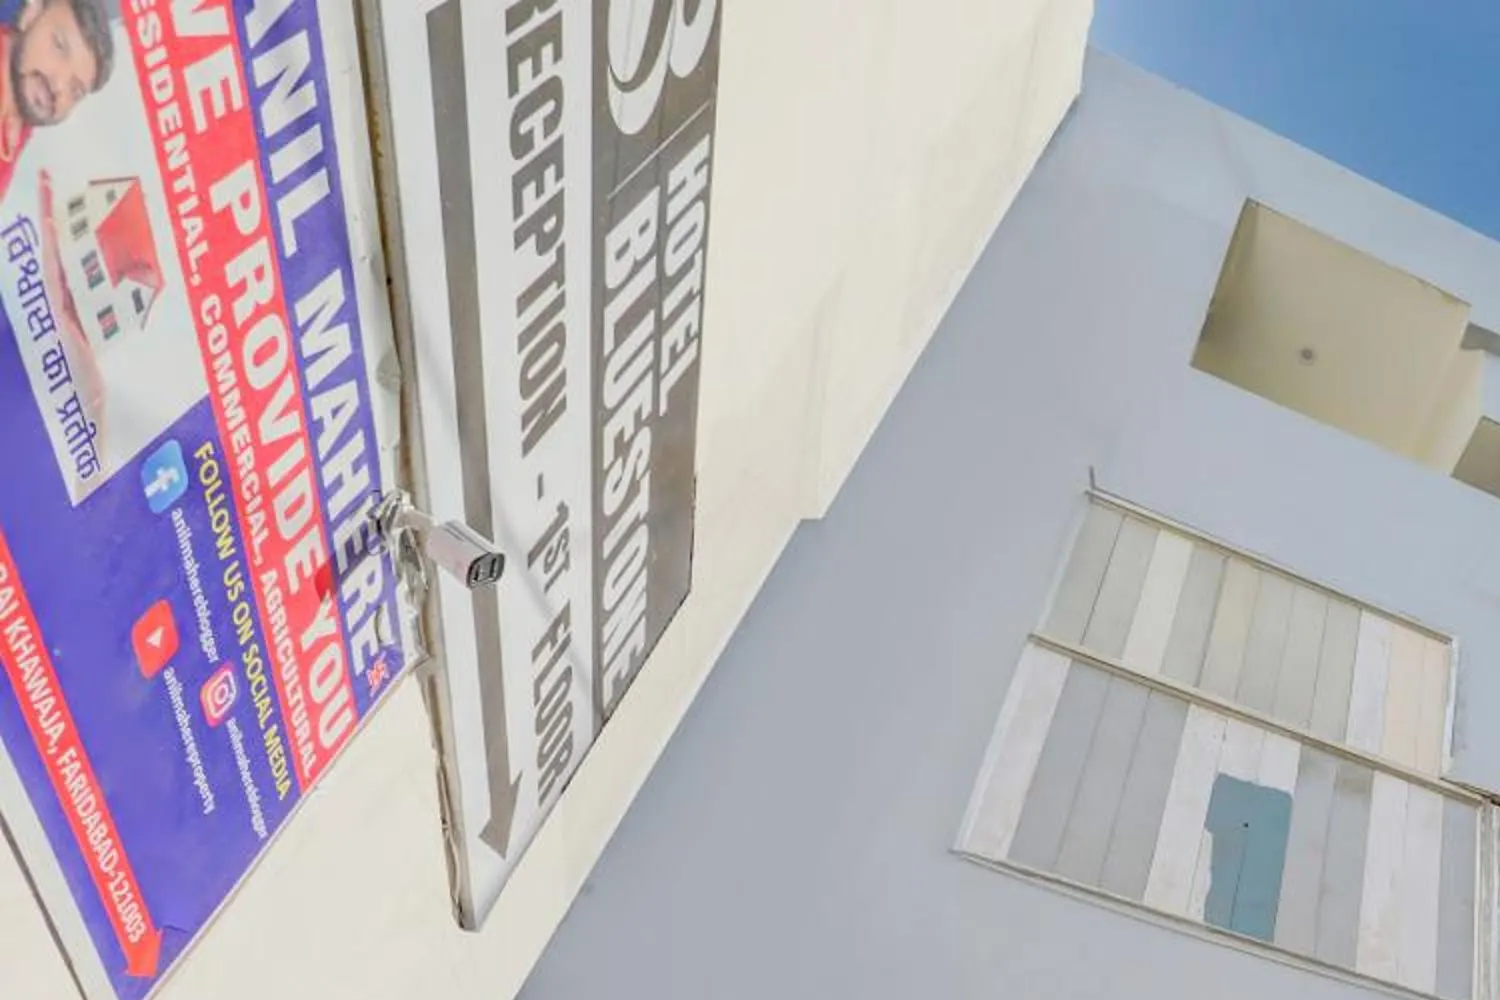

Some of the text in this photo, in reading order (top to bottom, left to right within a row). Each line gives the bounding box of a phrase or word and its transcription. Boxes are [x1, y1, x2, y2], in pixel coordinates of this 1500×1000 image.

[0, 213, 101, 480] विश्वास का प्रतीक
[505, 0, 566, 458] ECEPTION
[660, 135, 709, 416] HOTEL
[193, 441, 291, 800] FOLLOW US ON SOCIAL MEDIA
[200, 294, 267, 562] COMMERCIAL,
[260, 570, 317, 778] AGRICULTURAL
[209, 160, 326, 596] PROVIDE
[301, 589, 354, 750] YOU
[295, 268, 394, 676] MAHERE
[603, 186, 660, 708] BLUESTONE
[3, 616, 66, 754] KHAWAJA,
[532, 600, 573, 806] FLOOR
